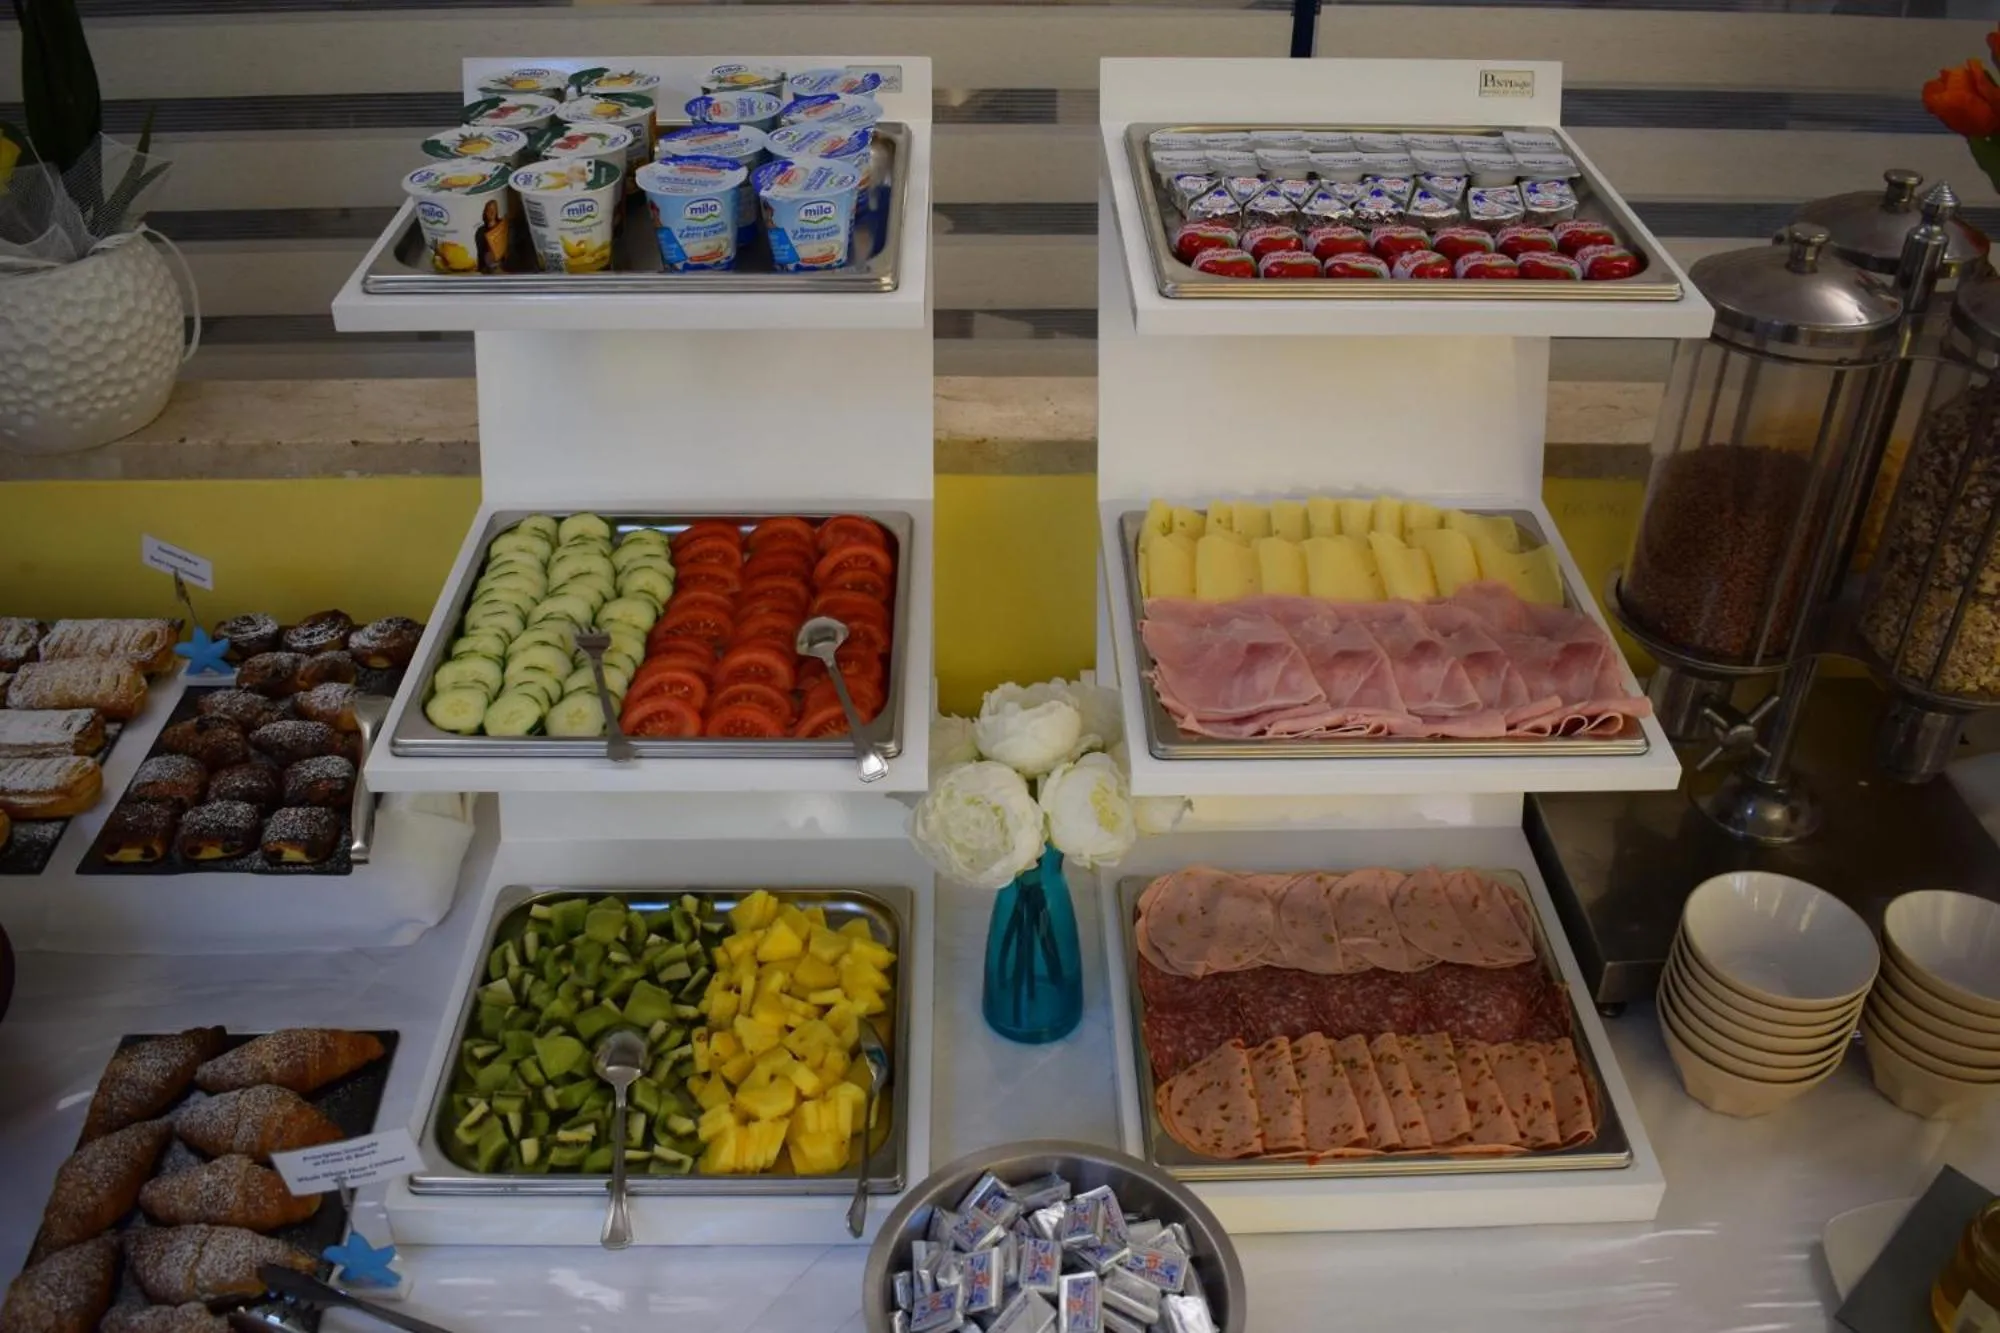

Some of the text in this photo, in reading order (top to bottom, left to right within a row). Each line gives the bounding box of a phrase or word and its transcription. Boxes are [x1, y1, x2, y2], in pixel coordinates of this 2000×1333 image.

[421, 206, 444, 219] mila
[567, 203, 595, 217] mila
[690, 203, 718, 215] mila
[804, 204, 832, 217] mila
